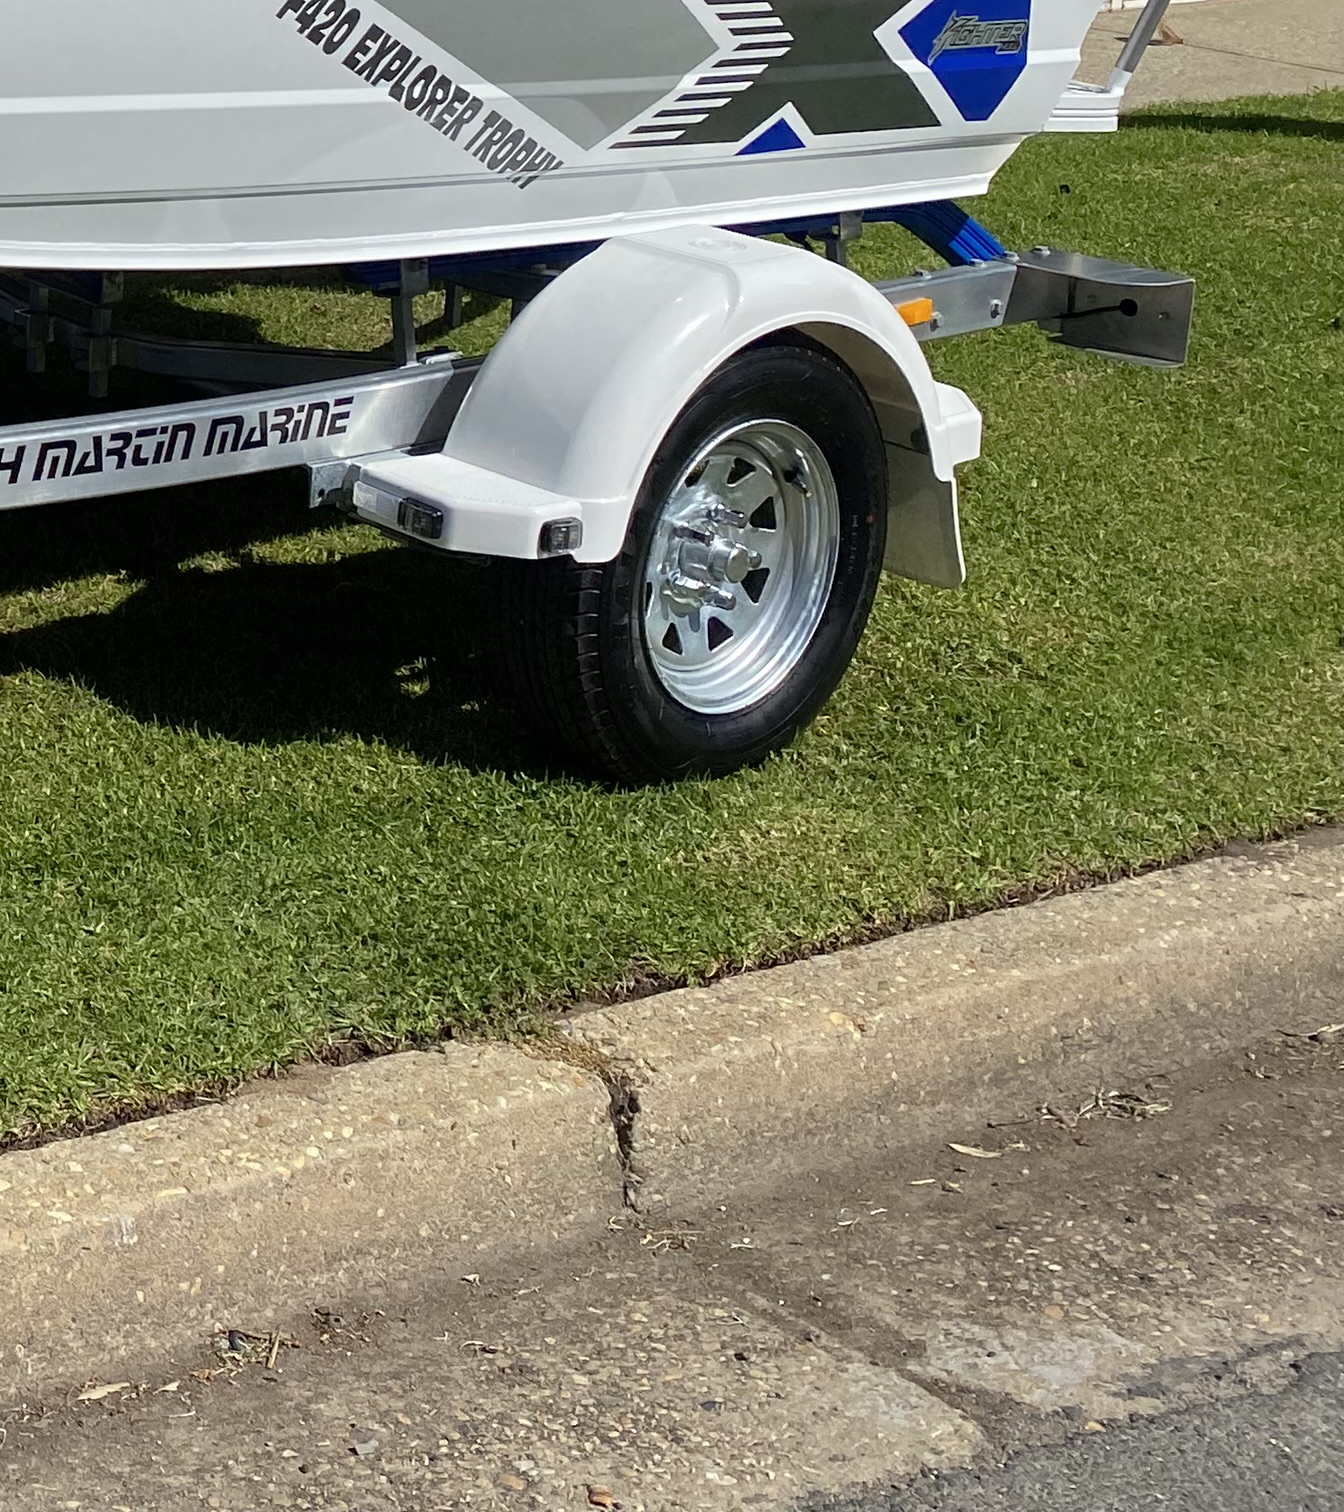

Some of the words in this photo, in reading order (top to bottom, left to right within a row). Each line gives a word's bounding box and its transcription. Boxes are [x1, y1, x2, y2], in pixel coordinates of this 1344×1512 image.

[341, 23, 484, 141] EXPLORER
[464, 108, 564, 190] TROPHY
[32, 422, 196, 482] MARTIN
[202, 396, 355, 456] MARINE
